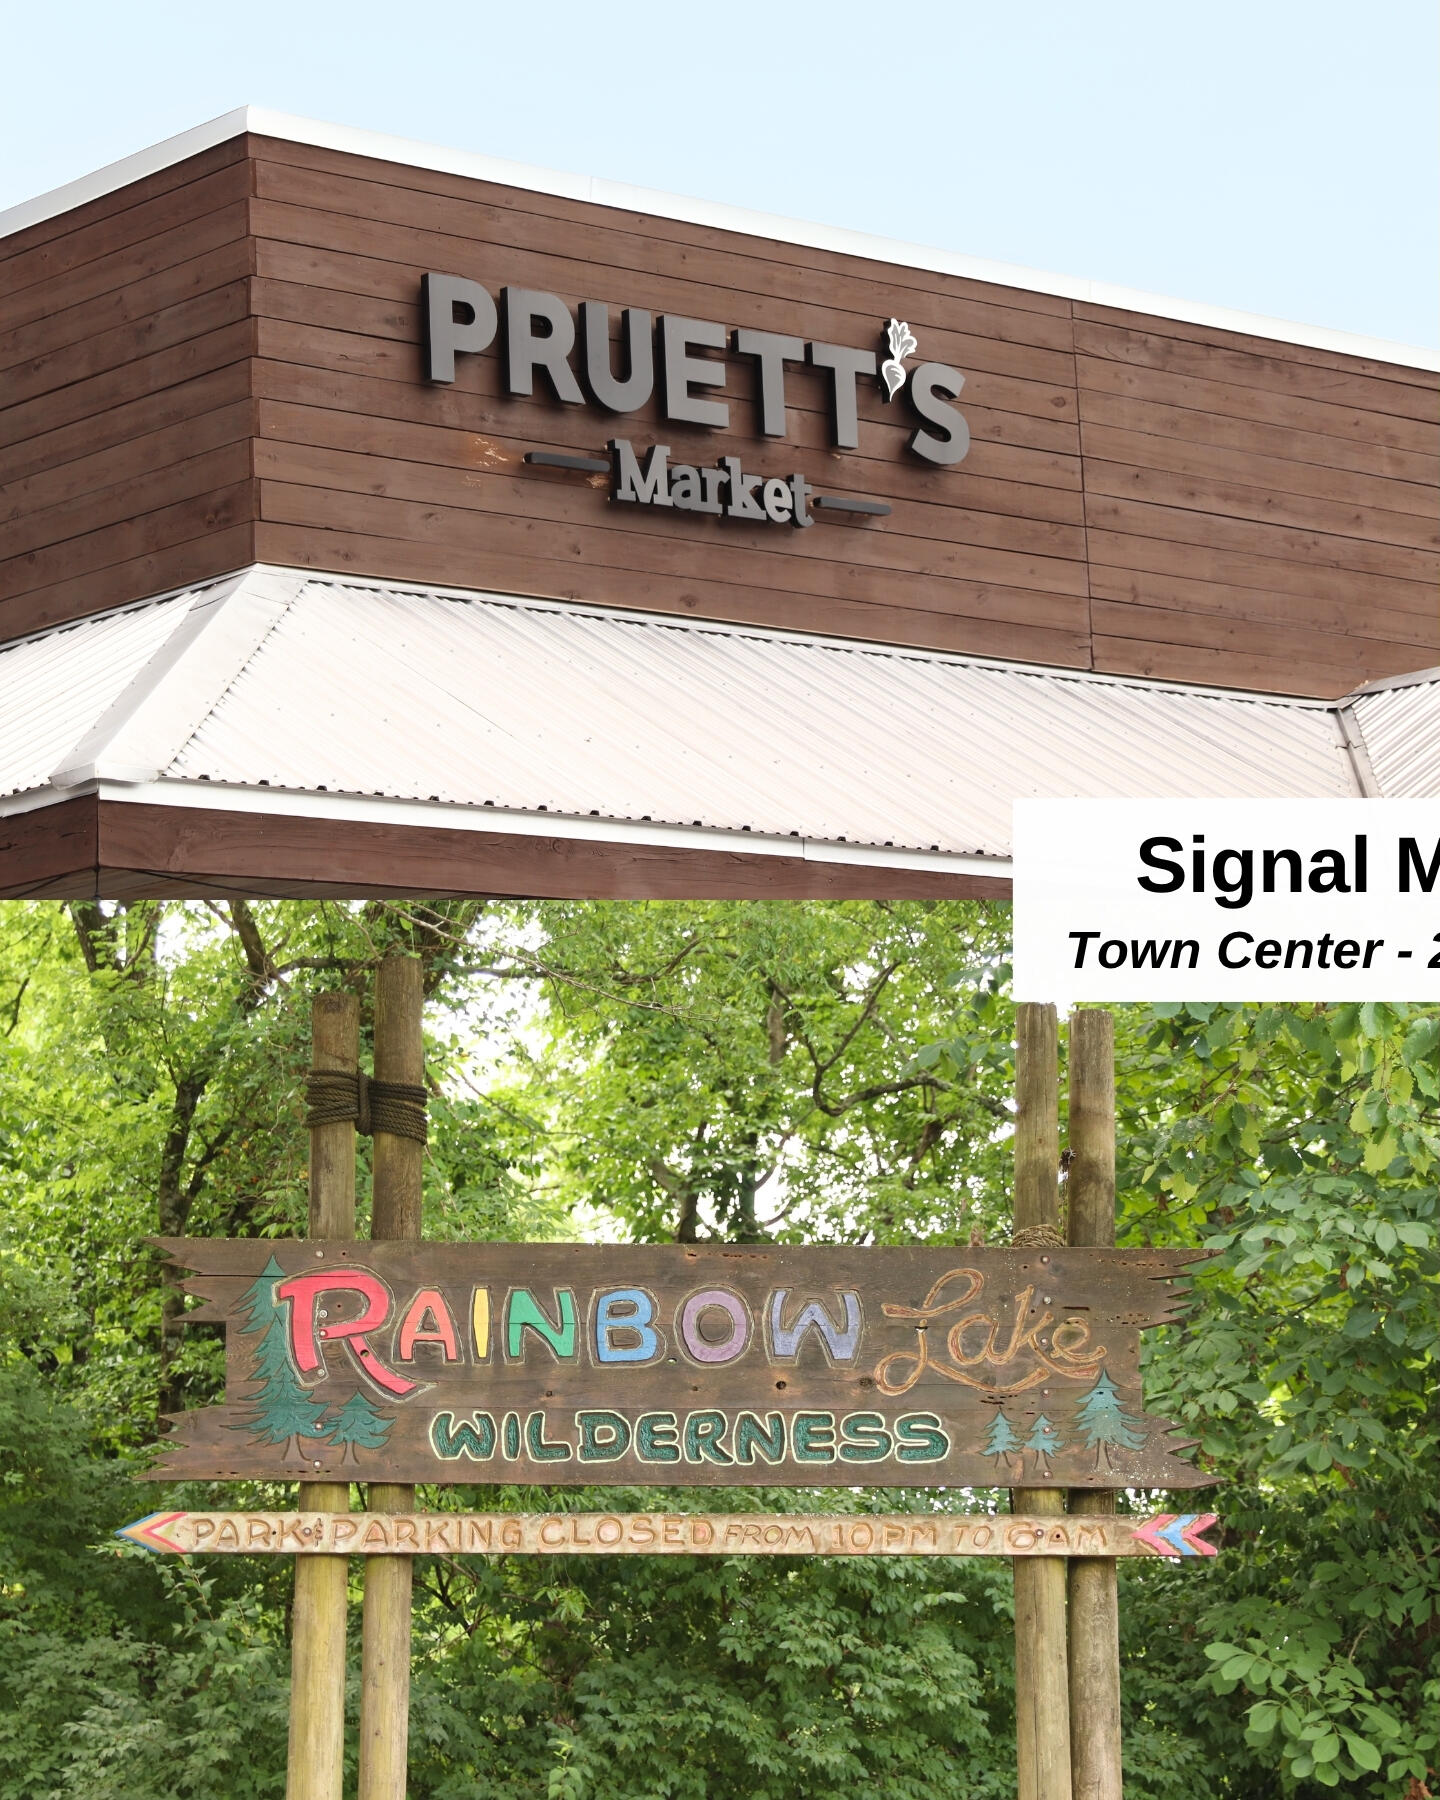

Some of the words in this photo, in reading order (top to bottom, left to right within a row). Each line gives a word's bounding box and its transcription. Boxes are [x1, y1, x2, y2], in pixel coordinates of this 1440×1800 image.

[605, 438, 814, 528] Market
[273, 1264, 866, 1401] RAINBOW
[874, 1267, 1107, 1396] Lake
[429, 1409, 949, 1464] WILDERNESS
[192, 1518, 303, 1547] PARK
[330, 1517, 522, 1549] PARKING
[538, 1516, 715, 1548] CLOSED
[724, 1524, 816, 1546] FROM
[954, 1525, 994, 1548] TO
